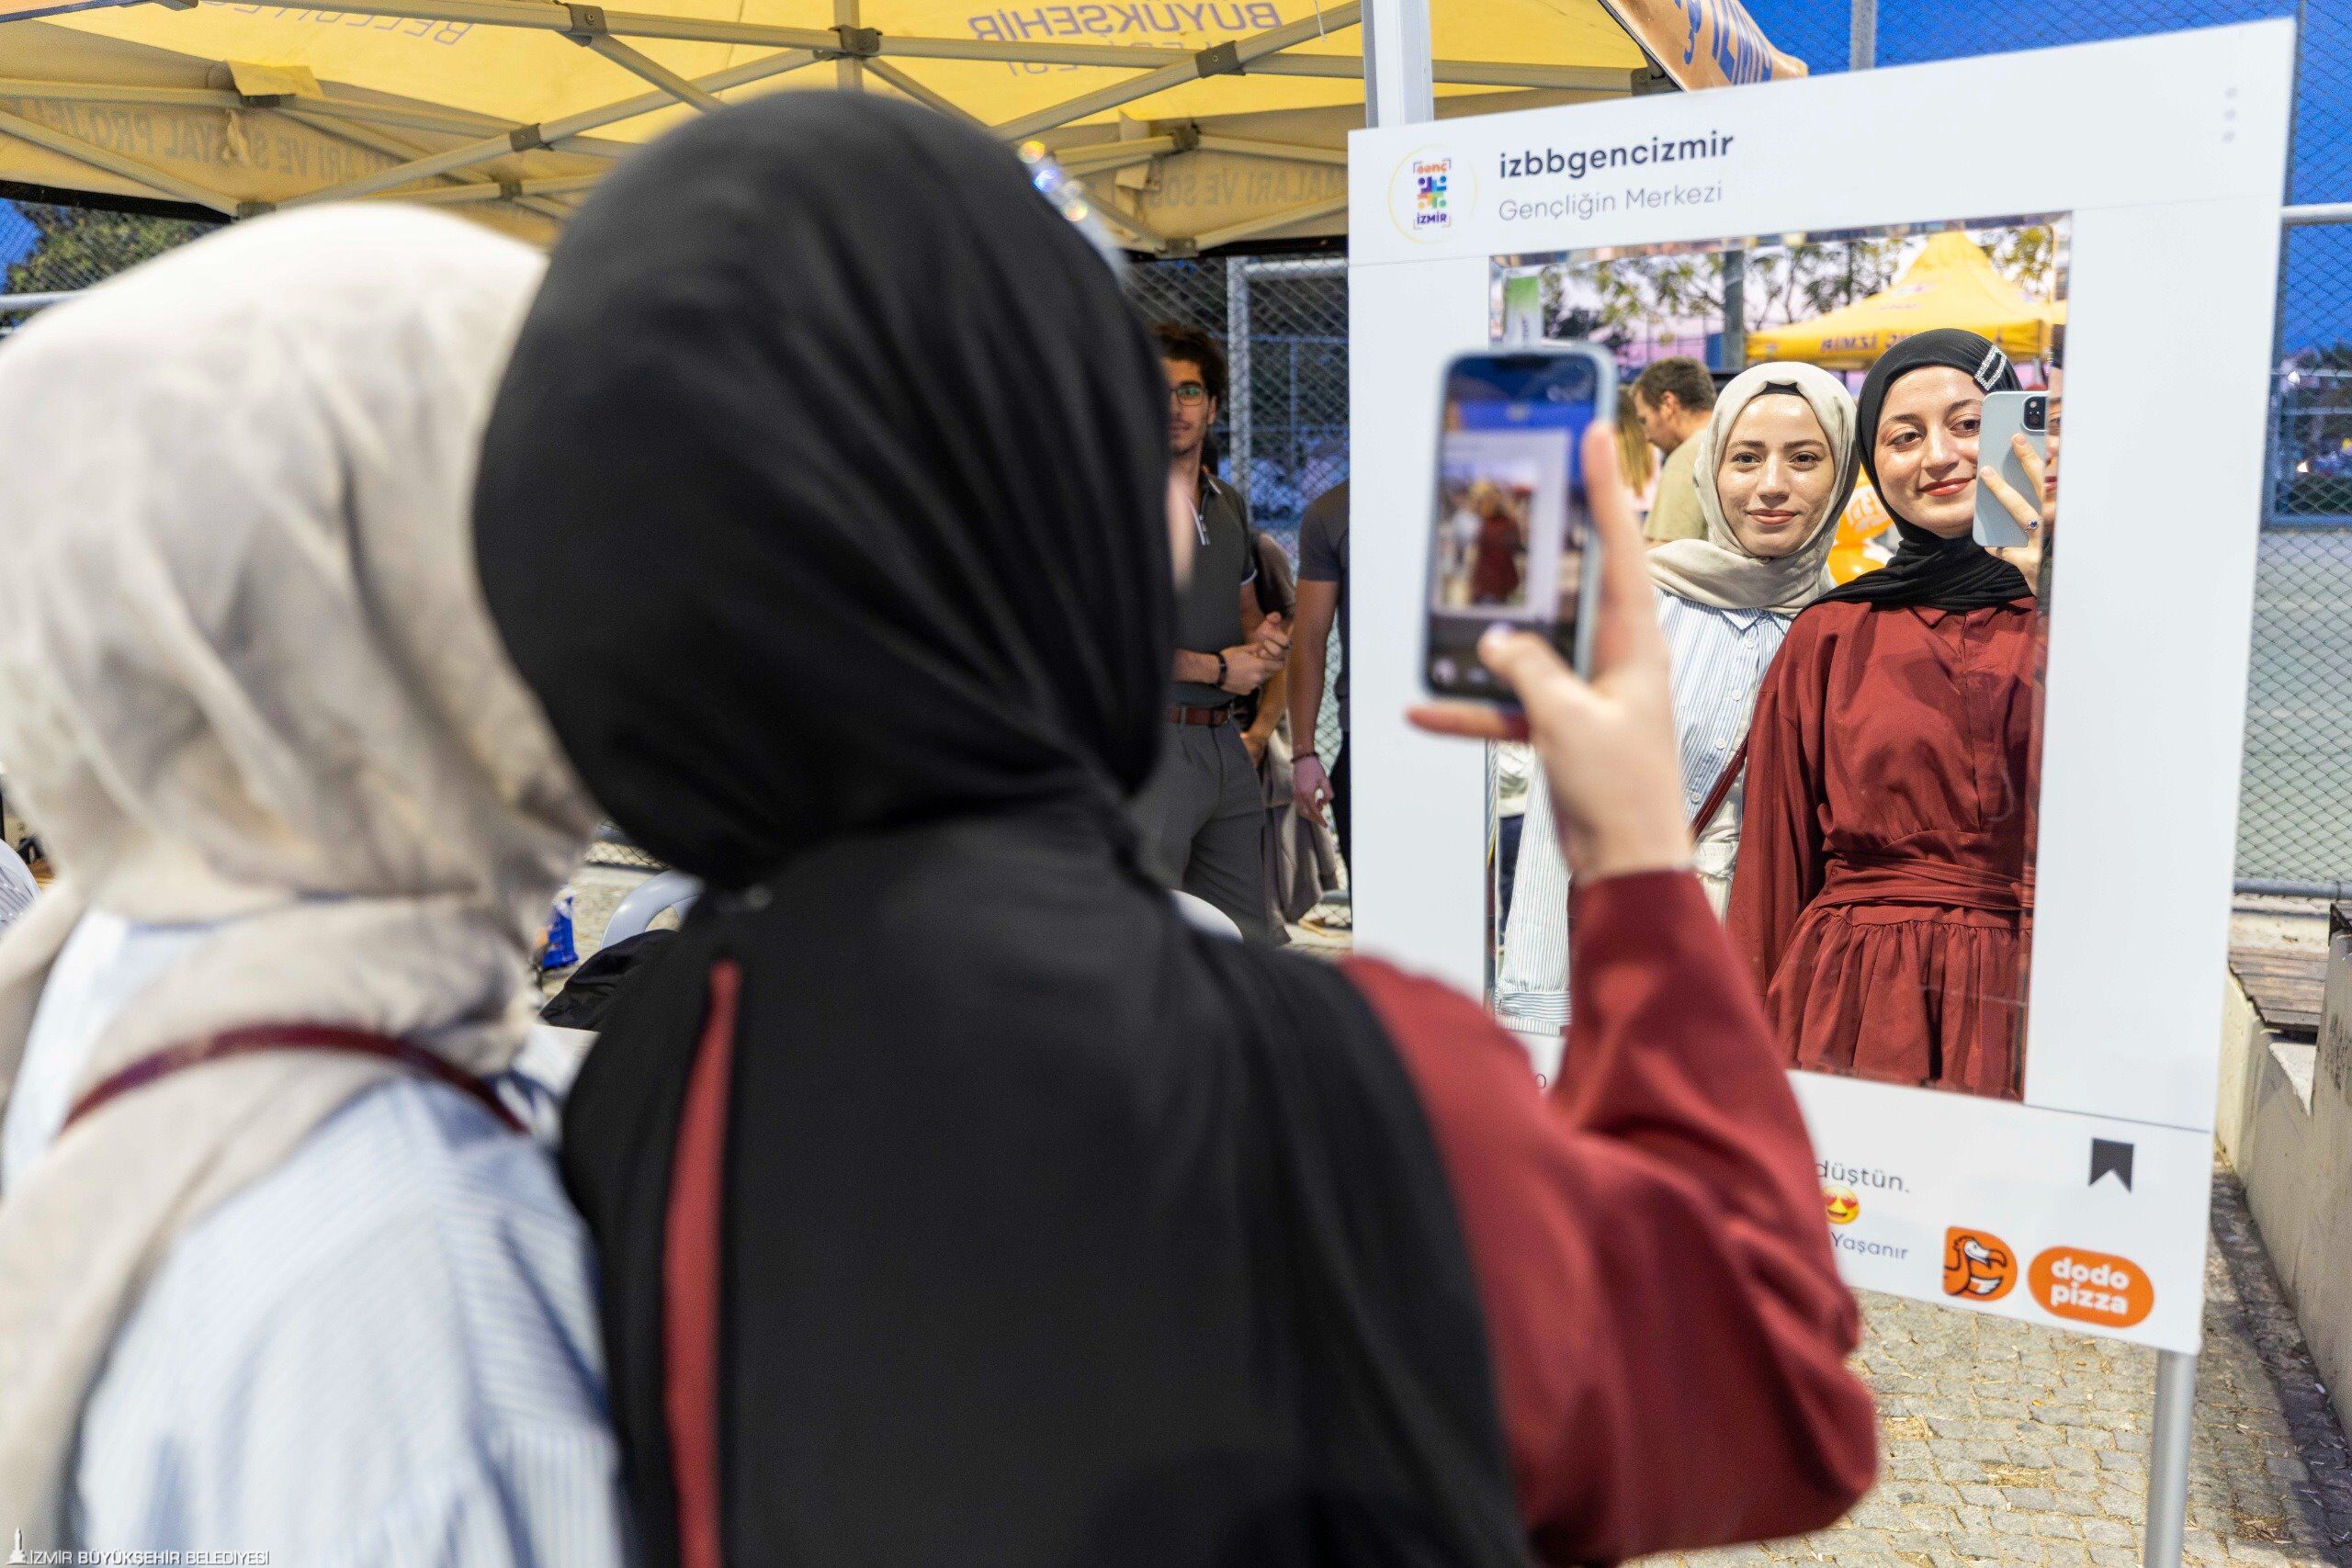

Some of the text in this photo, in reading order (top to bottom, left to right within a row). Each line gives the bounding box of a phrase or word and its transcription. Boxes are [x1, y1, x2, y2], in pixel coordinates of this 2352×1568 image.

[1499, 130, 1734, 179] izbbgencizmir
[1498, 181, 1723, 220] Gençliğin Merkezi
[1831, 1231, 1908, 1259] Yaşanır
[2051, 1256, 2130, 1291] dodo
[2050, 1280, 2129, 1315] pizza
